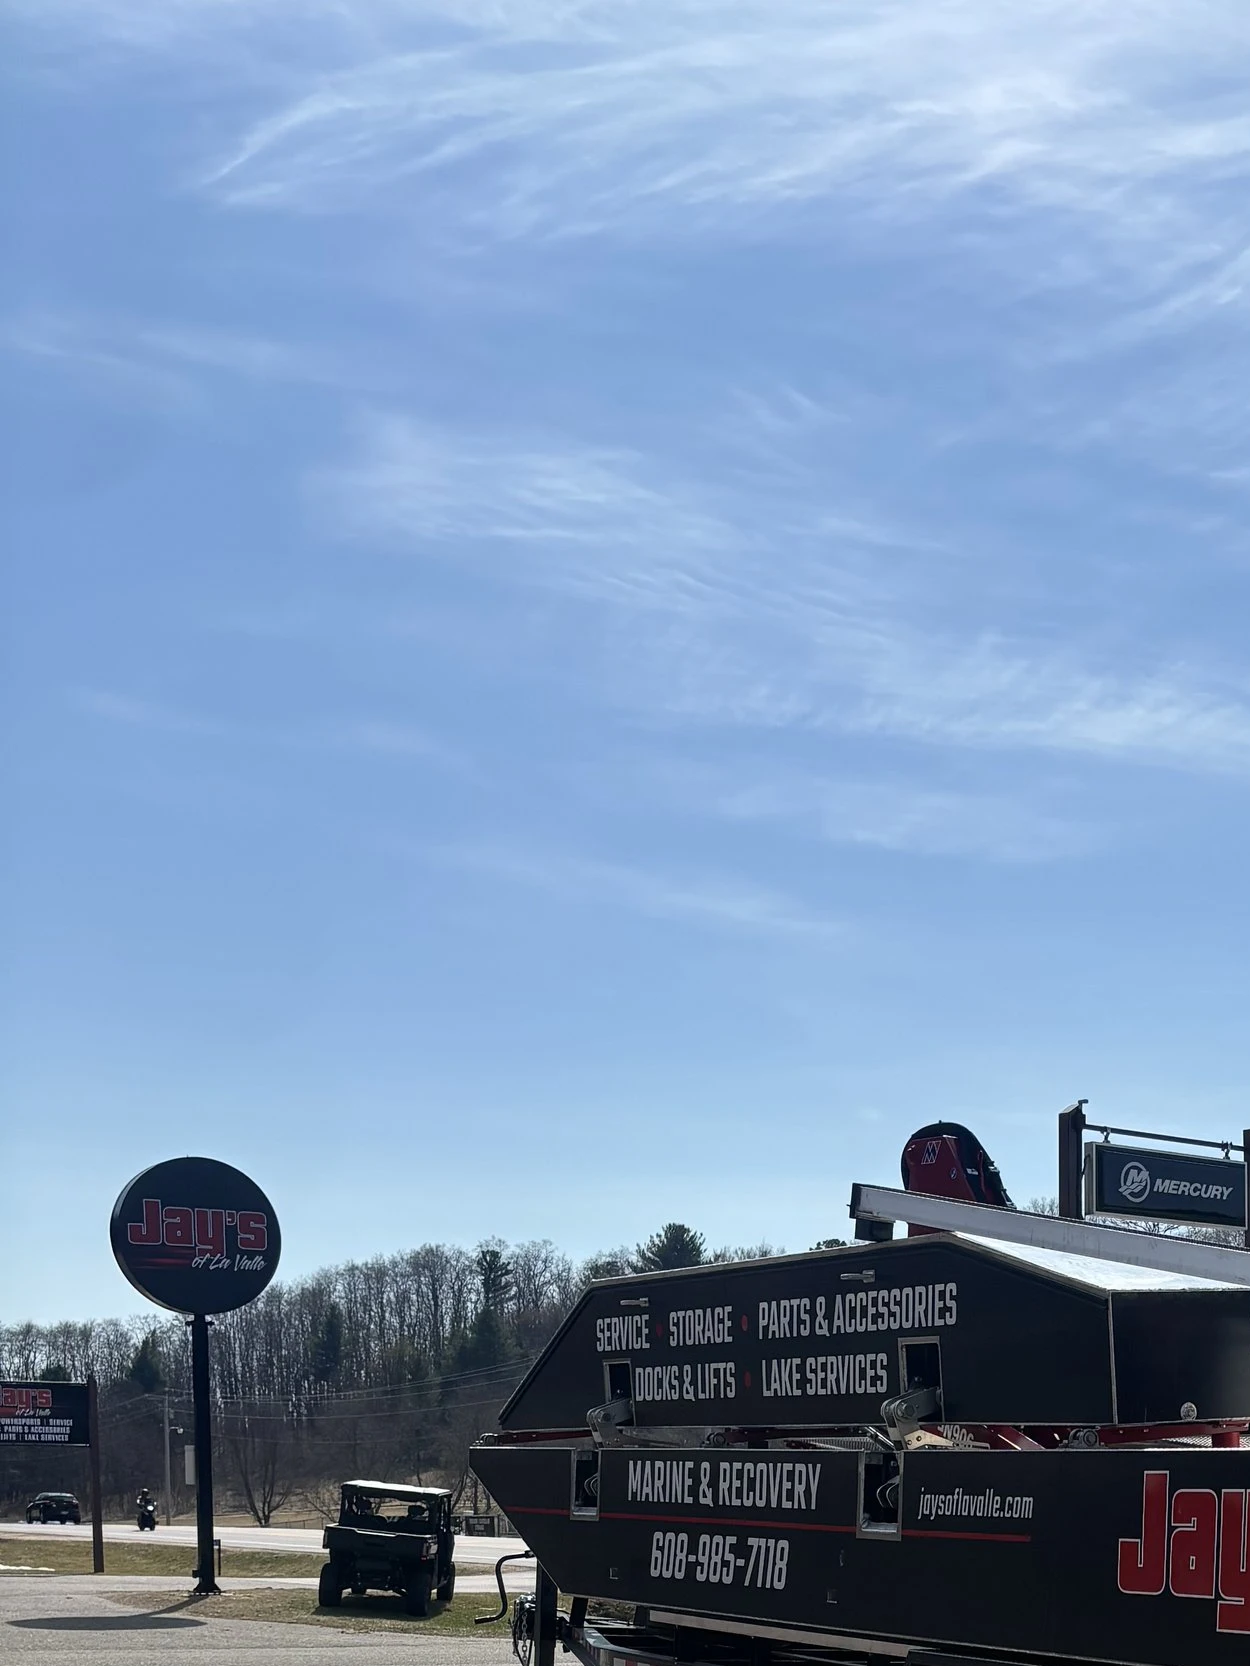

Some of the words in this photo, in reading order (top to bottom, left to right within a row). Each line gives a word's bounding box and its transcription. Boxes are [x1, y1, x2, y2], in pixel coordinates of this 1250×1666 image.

[1153, 1178, 1233, 1200] MERCURY
[127, 1198, 268, 1259] Jay's
[191, 1253, 211, 1270] of
[210, 1253, 232, 1270] La
[233, 1254, 267, 1272] Valle
[596, 1314, 650, 1352] SERVICE
[669, 1305, 733, 1347] STORAGE
[758, 1298, 811, 1340] PARTS
[815, 1296, 830, 1337] &
[832, 1282, 958, 1334] ACCESSORIES
[0, 1385, 52, 1411] ay's
[635, 1364, 681, 1401] DOCKS
[683, 1364, 696, 1401] &
[697, 1362, 736, 1399] LIFTS
[762, 1356, 802, 1397] LAKE
[805, 1353, 888, 1396] SERVICES
[628, 1459, 694, 1503] MARINE
[699, 1463, 714, 1508] &
[718, 1462, 821, 1510] RECOVERY
[917, 1486, 1034, 1520] jaysoflavalle.com
[650, 1531, 790, 1590] 608-985-7118
